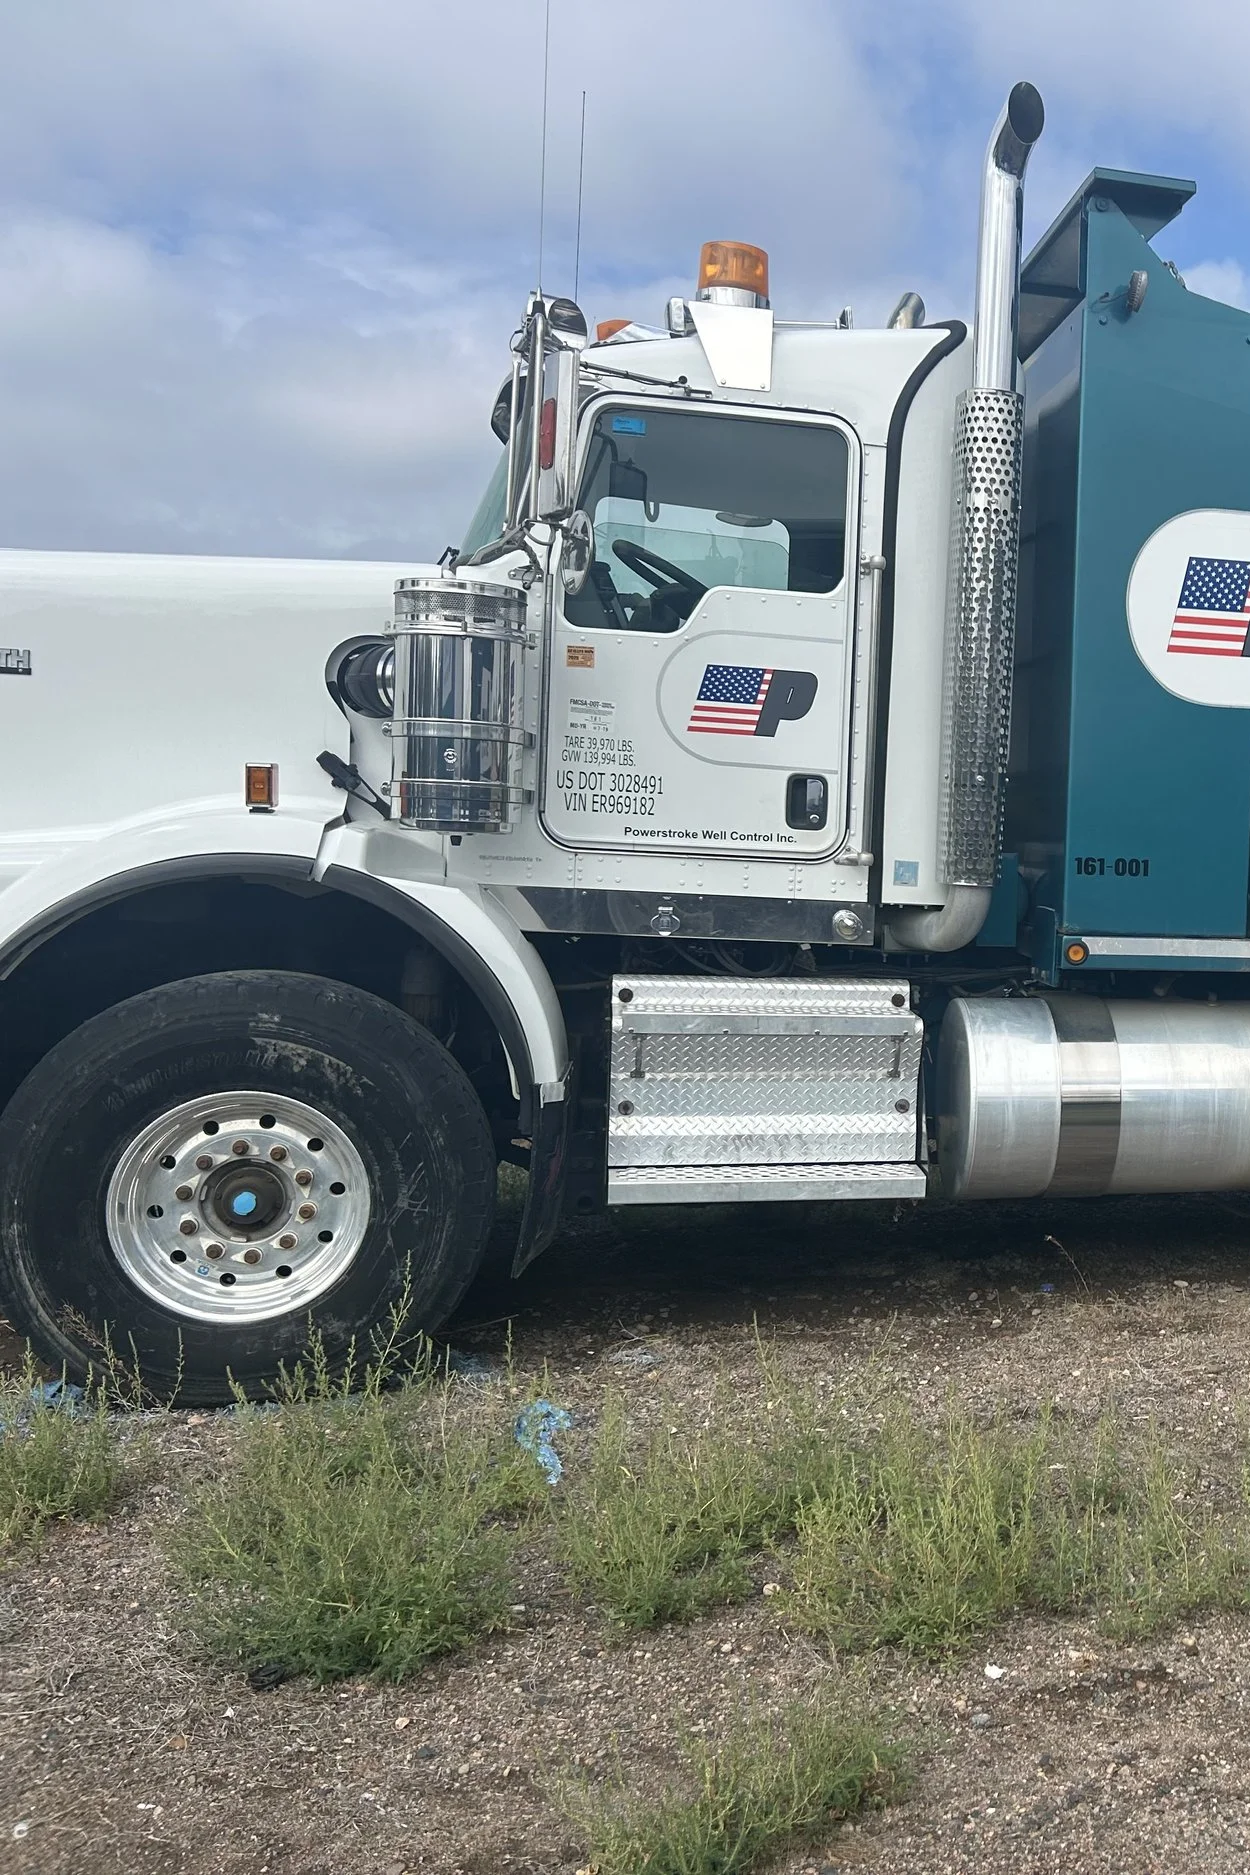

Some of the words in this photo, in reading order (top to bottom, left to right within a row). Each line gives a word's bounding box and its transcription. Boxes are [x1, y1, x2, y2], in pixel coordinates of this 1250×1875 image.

[754, 669, 819, 738] P
[564, 735, 585, 749] TARE
[587, 737, 615, 752] 39,970
[617, 739, 635, 753] LBS.
[562, 749, 581, 762] GVW
[584, 751, 616, 766] 139,994
[618, 753, 636, 767] LBS.
[556, 770, 574, 789] US
[578, 771, 606, 791] DOT
[609, 773, 664, 795] 3028491
[563, 792, 587, 812] VIN
[591, 793, 655, 816] ER969182
[624, 826, 698, 839] Powerstroke
[702, 830, 727, 841] Well
[730, 831, 773, 842] Control
[776, 833, 797, 843] Inc.
[1074, 856, 1150, 877] 161-001
